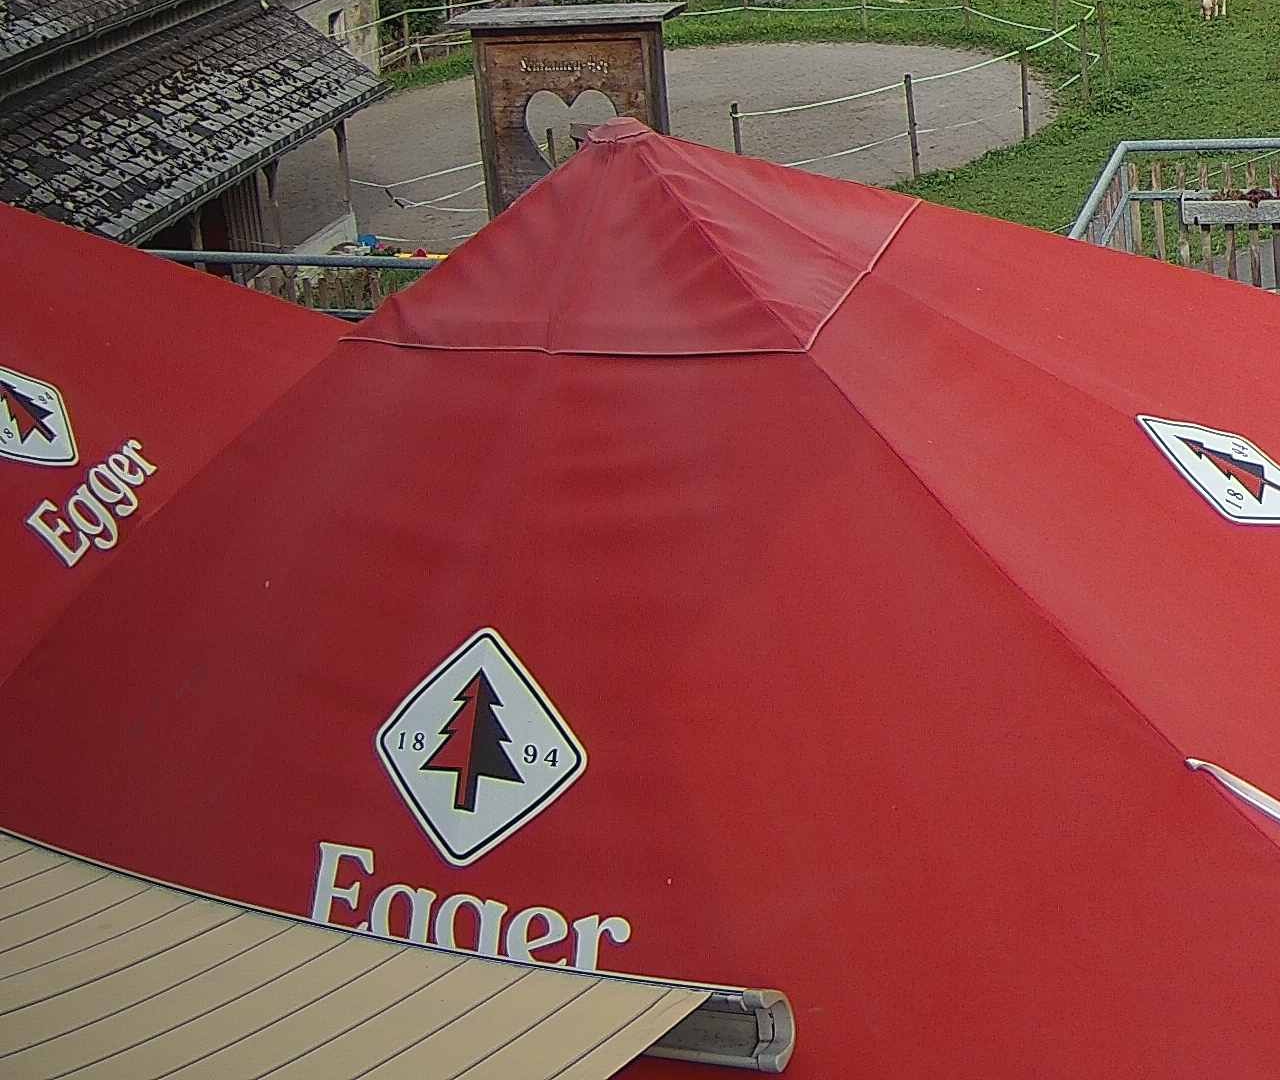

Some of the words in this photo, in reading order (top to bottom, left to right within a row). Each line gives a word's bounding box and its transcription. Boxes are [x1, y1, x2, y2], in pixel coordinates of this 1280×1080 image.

[26, 439, 158, 568] Egger
[1225, 488, 1244, 510] 18
[397, 731, 426, 752] 18
[523, 744, 559, 768] 94
